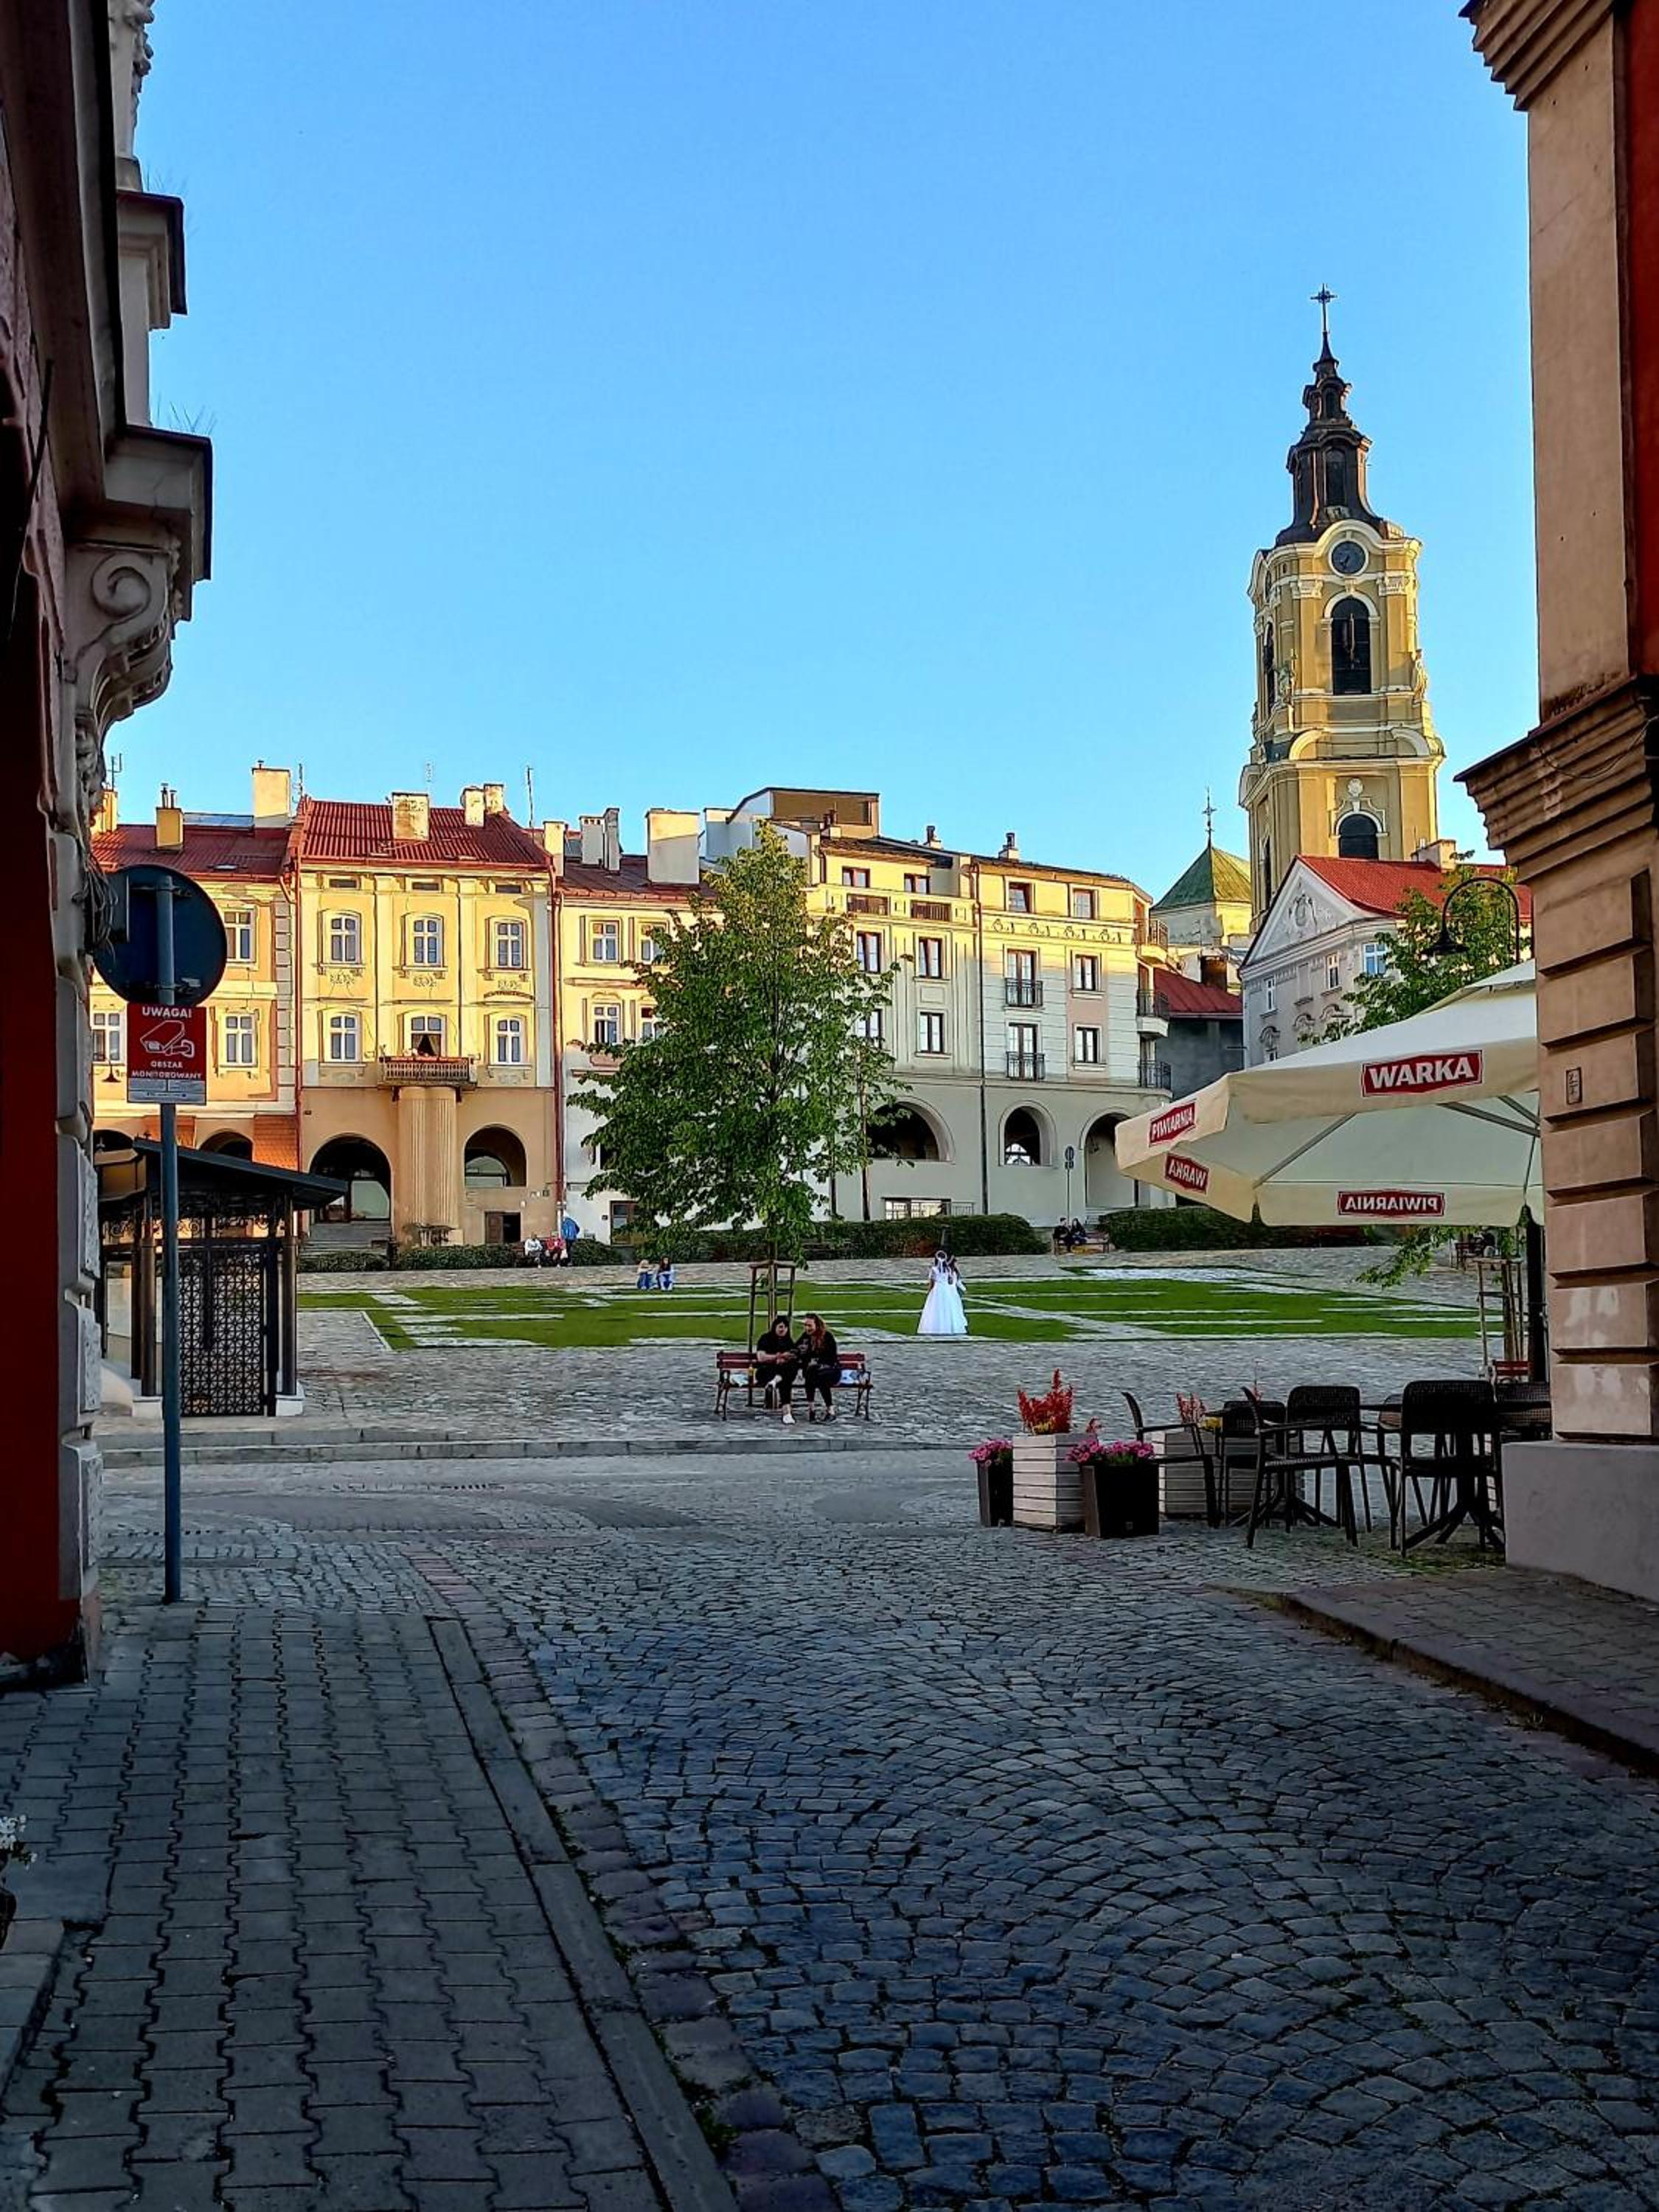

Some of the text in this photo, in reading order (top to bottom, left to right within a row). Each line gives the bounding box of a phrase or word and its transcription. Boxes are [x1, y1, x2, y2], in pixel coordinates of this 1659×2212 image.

[142, 1006, 192, 1018] UWAGA!
[150, 1060, 183, 1068] OBSZAR
[131, 1070, 201, 1079] MONITOROWANY
[1368, 1057, 1475, 1089] WARKA
[1151, 1107, 1193, 1141] PIWIARNIA
